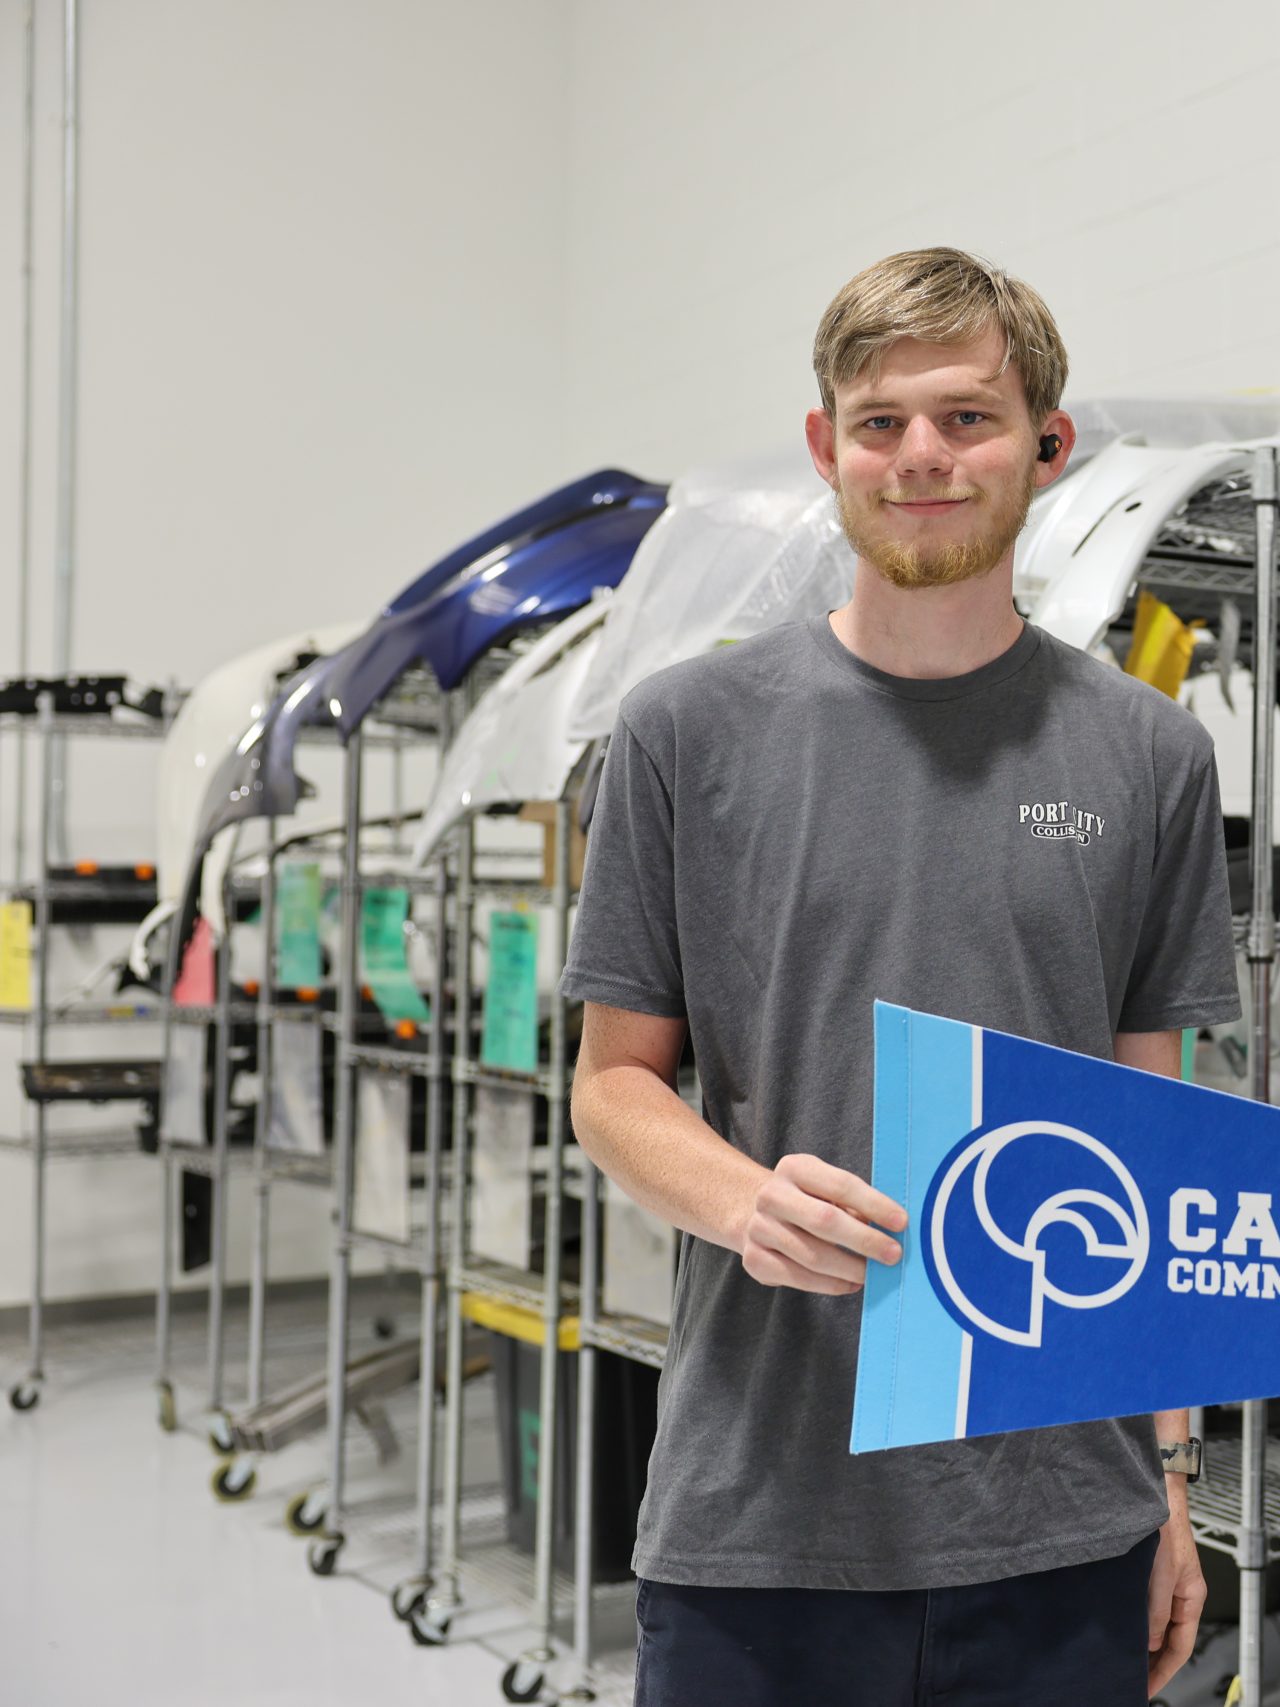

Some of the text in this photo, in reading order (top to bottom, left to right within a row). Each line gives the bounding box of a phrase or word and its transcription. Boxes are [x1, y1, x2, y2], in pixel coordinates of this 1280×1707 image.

[1019, 801, 1105, 837] PORT ITY
[1036, 826, 1085, 843] COLLISN
